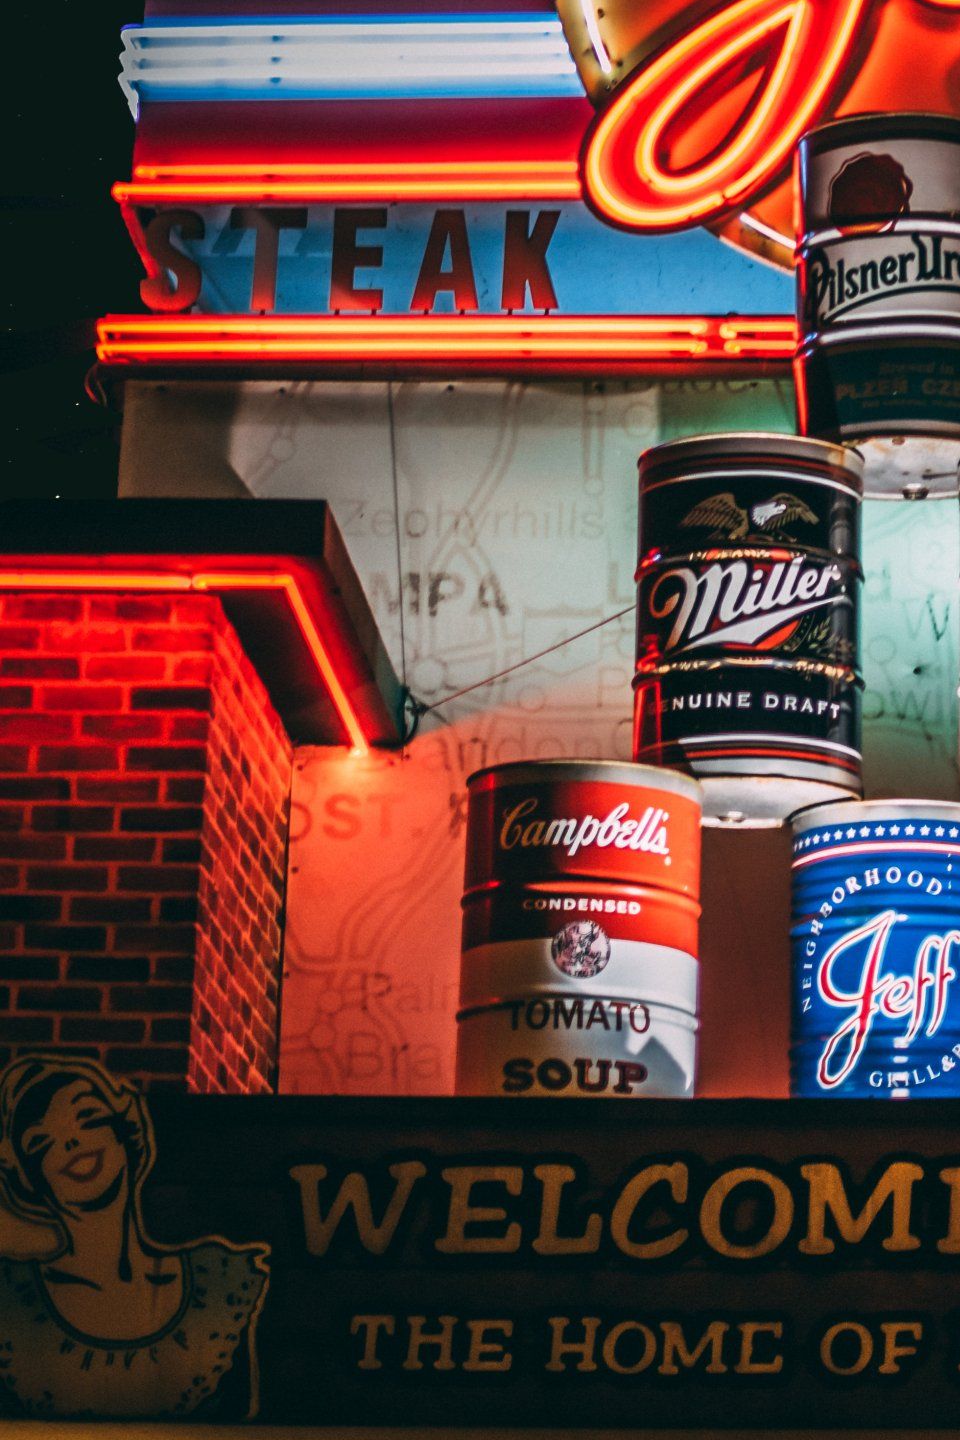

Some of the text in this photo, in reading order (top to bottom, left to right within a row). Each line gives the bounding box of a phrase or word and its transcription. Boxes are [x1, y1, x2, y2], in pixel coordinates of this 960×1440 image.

[140, 206, 562, 312] STEAK
[804, 245, 916, 329] Pilsner
[342, 498, 606, 546] Zephyrhills
[650, 554, 842, 652] Miller
[765, 694, 840, 720] DRAFT
[499, 797, 671, 857] Campbell's
[523, 898, 642, 916] CONDENSED
[801, 865, 943, 1013] NEIGHBORHOOD
[507, 999, 651, 1035] TOMATO
[502, 1057, 650, 1095] SOUP
[350, 1314, 514, 1372] THE
[545, 1315, 785, 1375] HOME
[820, 1320, 924, 1375] OF
